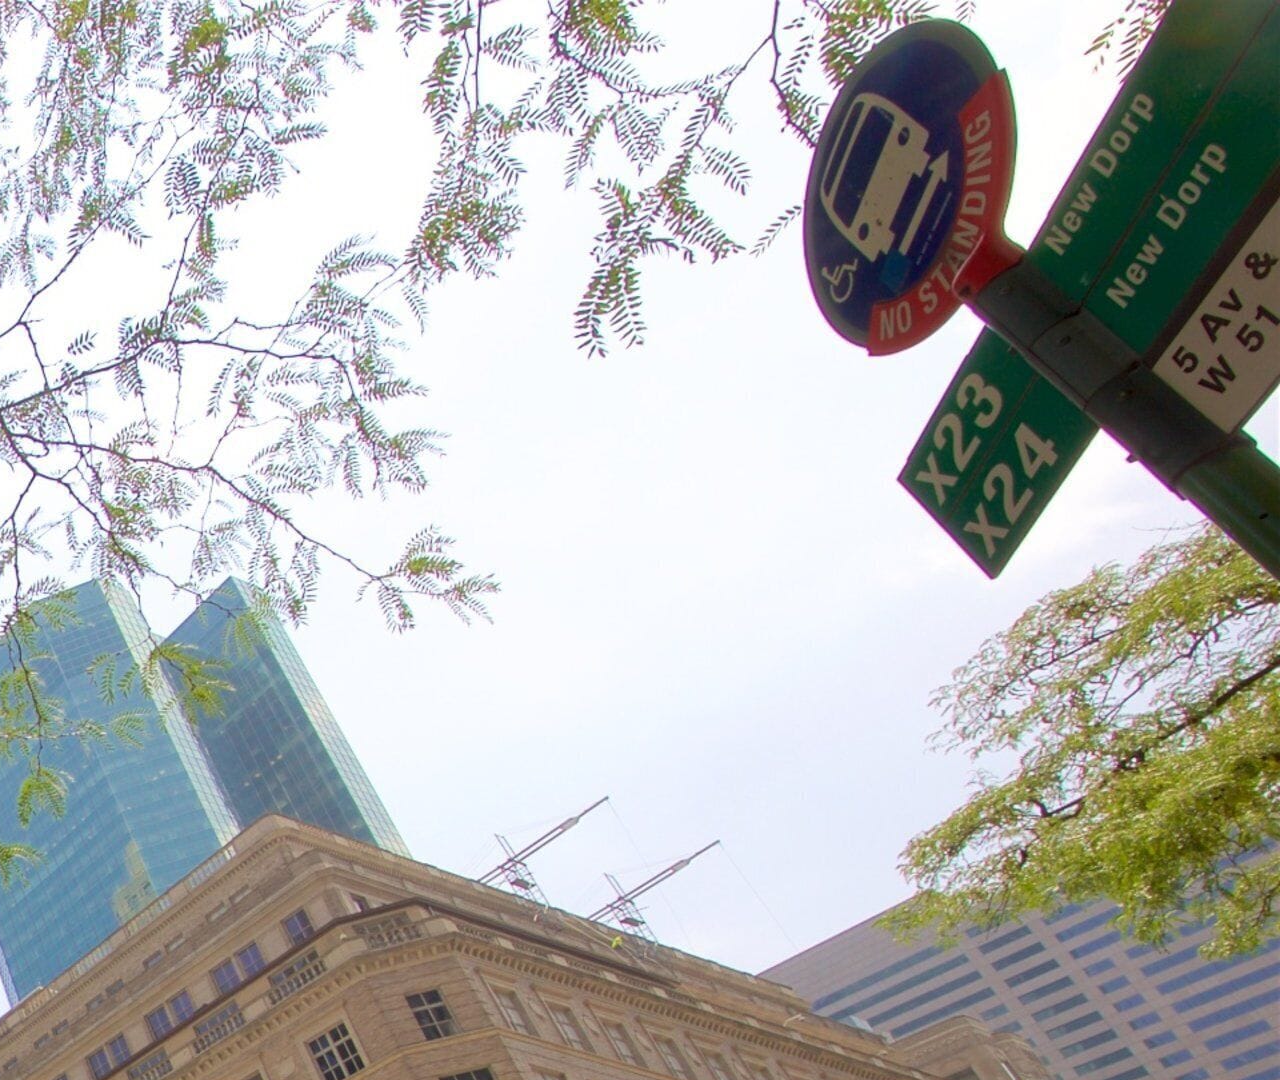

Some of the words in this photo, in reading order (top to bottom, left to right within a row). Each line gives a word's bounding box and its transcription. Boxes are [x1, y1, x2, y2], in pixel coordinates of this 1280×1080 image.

[880, 301, 912, 341] NO
[919, 110, 992, 314] STANDING
[1044, 182, 1098, 256] New
[1090, 93, 1154, 179] Dorp
[1106, 234, 1164, 309] New
[1156, 143, 1227, 231] Dorp
[1172, 346, 1199, 374] 5
[1200, 288, 1243, 344] Av
[1244, 251, 1279, 280] &
[1198, 354, 1237, 394] W
[1236, 304, 1280, 353] 51
[915, 373, 1003, 507] X23
[963, 422, 1058, 559] X24
